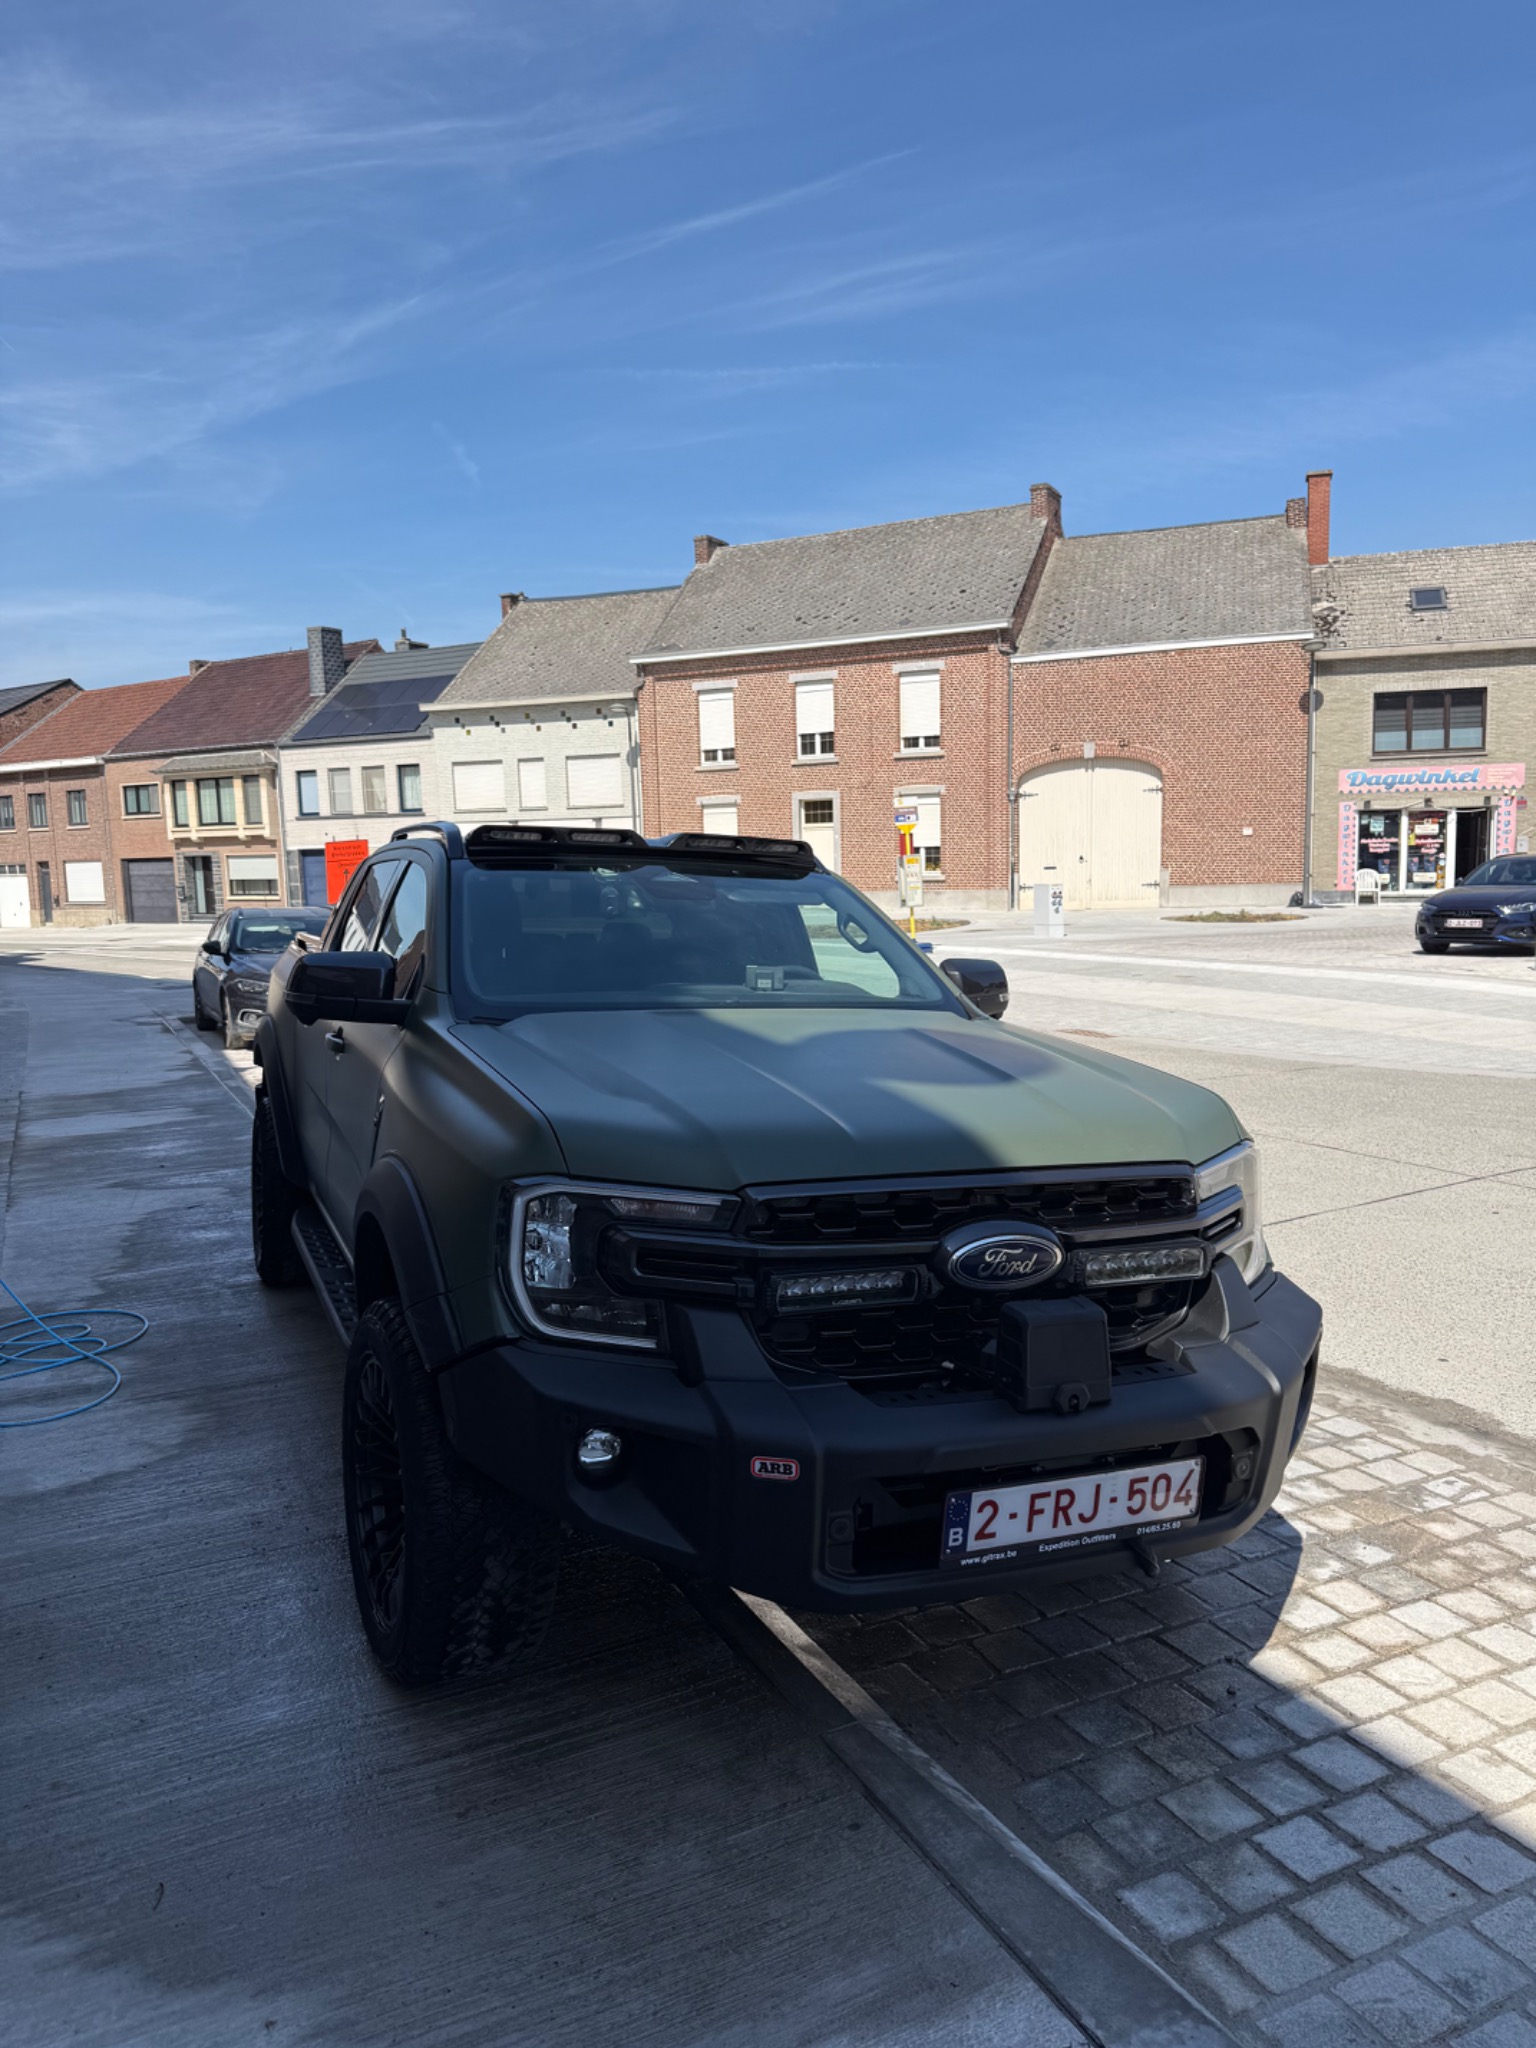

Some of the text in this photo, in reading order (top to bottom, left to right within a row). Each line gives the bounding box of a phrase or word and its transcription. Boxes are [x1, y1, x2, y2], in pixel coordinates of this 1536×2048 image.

[1346, 768, 1481, 790] Dagwinkel
[978, 1248, 1038, 1277] Ford
[757, 1461, 793, 1476] ARB
[949, 1469, 1196, 1546] B 2-FRJ-504
[1039, 1538, 1080, 1551] Expedition
[1081, 1533, 1117, 1545] Outfitters
